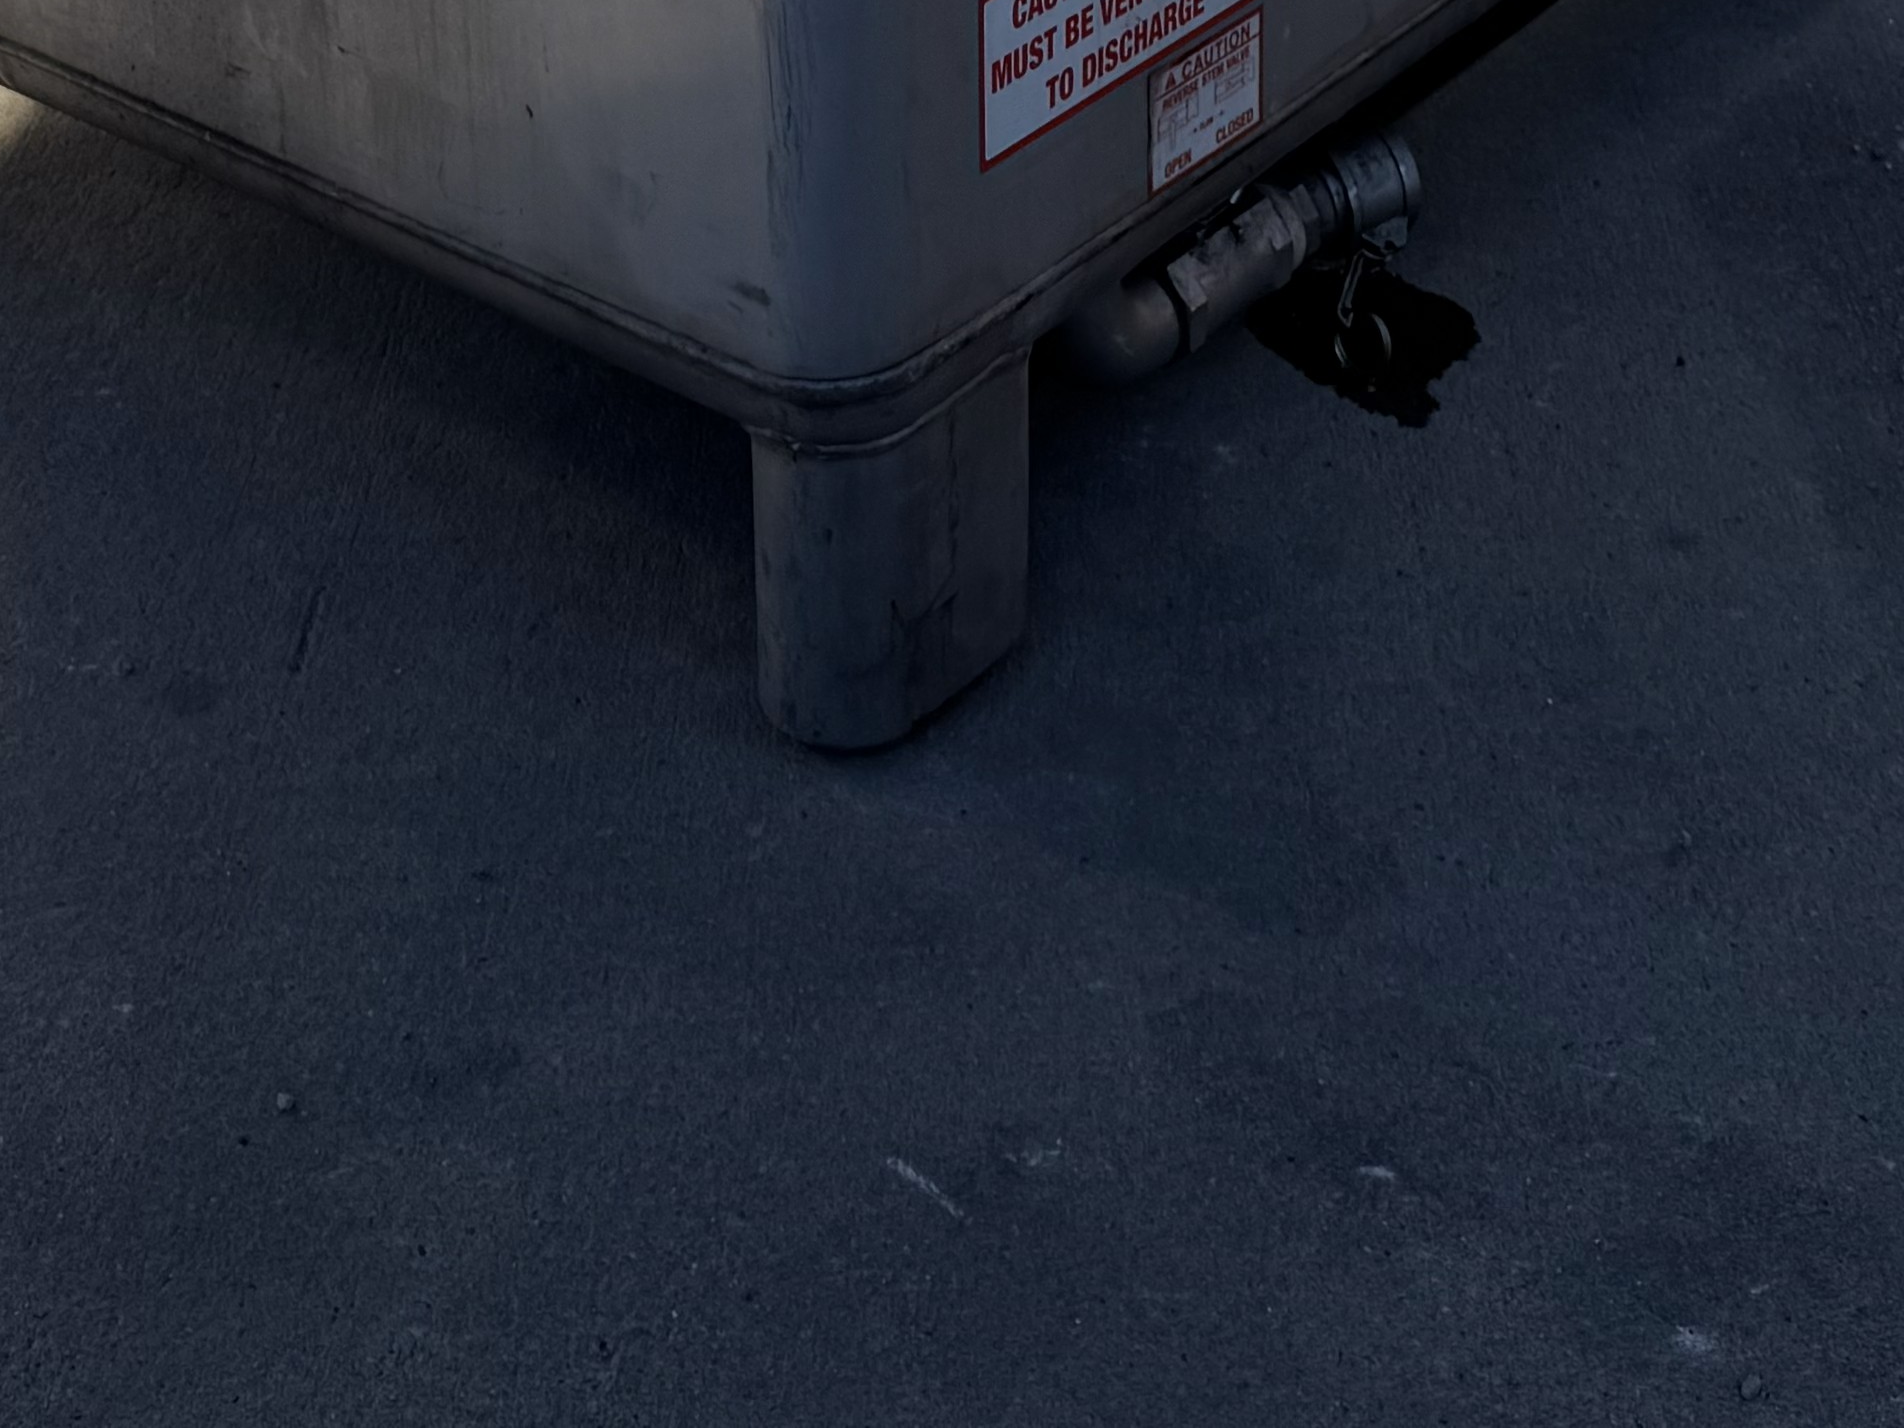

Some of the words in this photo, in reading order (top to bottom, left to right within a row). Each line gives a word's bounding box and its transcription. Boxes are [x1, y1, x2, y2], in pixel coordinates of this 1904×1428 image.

[991, 25, 1058, 95] MUST
[1065, 3, 1094, 50] BE
[1181, 22, 1251, 82] CAUTION
[1046, 66, 1075, 109] TO
[1162, 80, 1200, 112] REVERSE
[1215, 106, 1255, 144] CLOSED
[1164, 148, 1193, 180] OPEN
